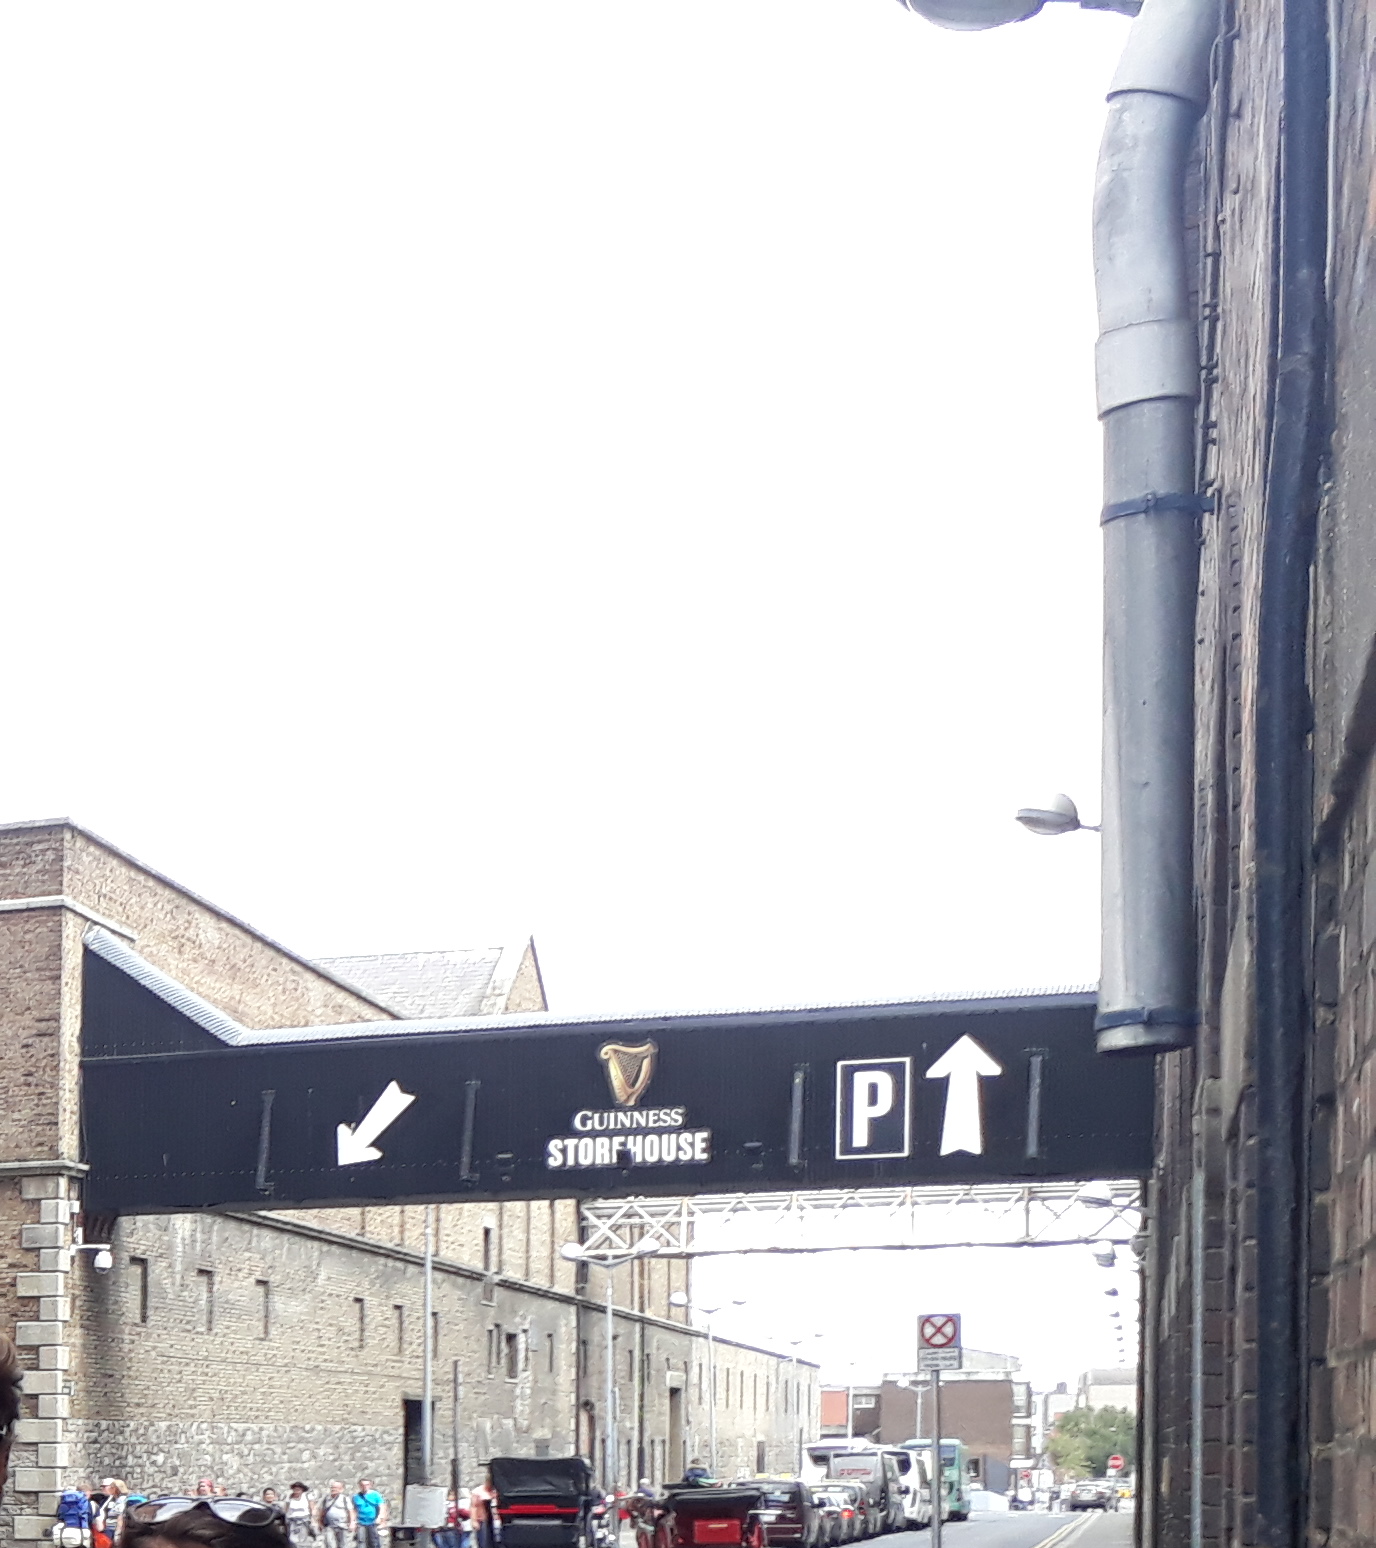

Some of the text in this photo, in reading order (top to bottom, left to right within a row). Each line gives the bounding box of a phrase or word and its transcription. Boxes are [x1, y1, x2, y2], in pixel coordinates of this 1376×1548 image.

[573, 1108, 685, 1131] GUINNESS
[852, 1070, 893, 1147] P
[547, 1131, 709, 1167] STOREHOUSE
